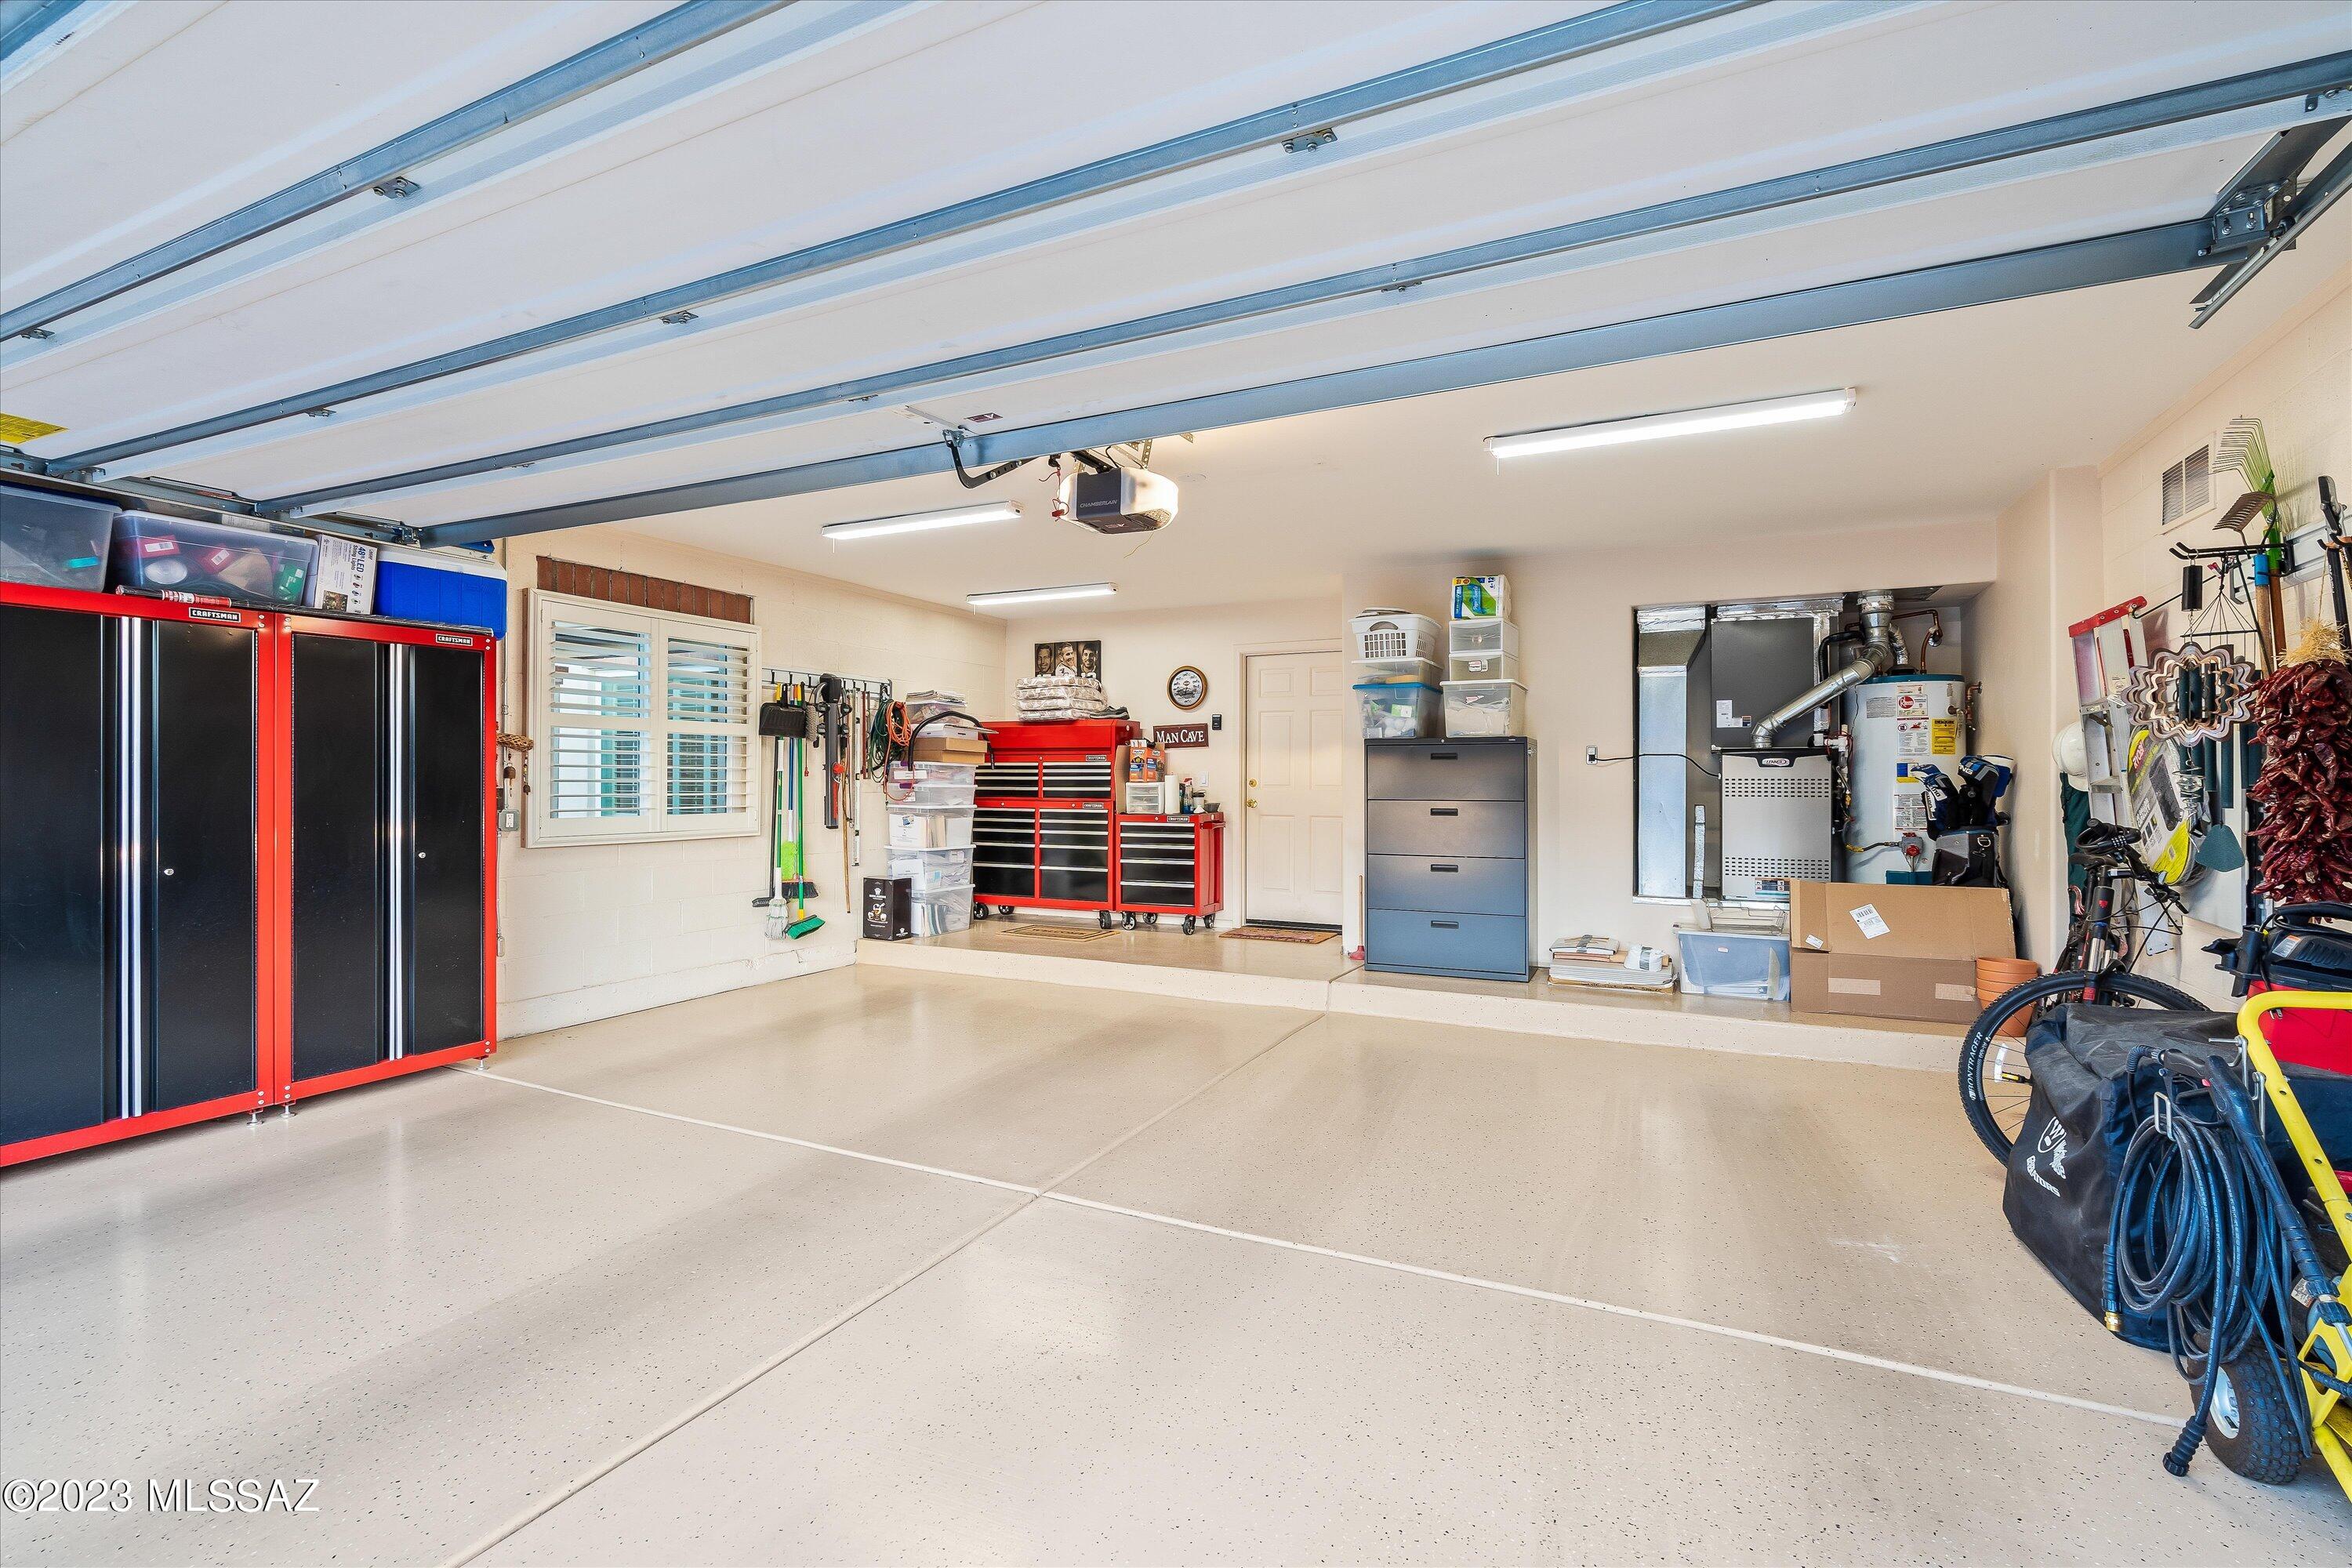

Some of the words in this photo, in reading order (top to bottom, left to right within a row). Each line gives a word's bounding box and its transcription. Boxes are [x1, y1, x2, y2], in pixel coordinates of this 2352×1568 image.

[1080, 499, 1118, 508] CHAMBERLAIN
[356, 558, 365, 573] LED
[192, 610, 238, 620] CRAFTSMAN
[1156, 731, 1179, 743] MAN
[1180, 729, 1205, 743] CAVE
[1967, 1031, 1984, 1092] BONTRAGER
